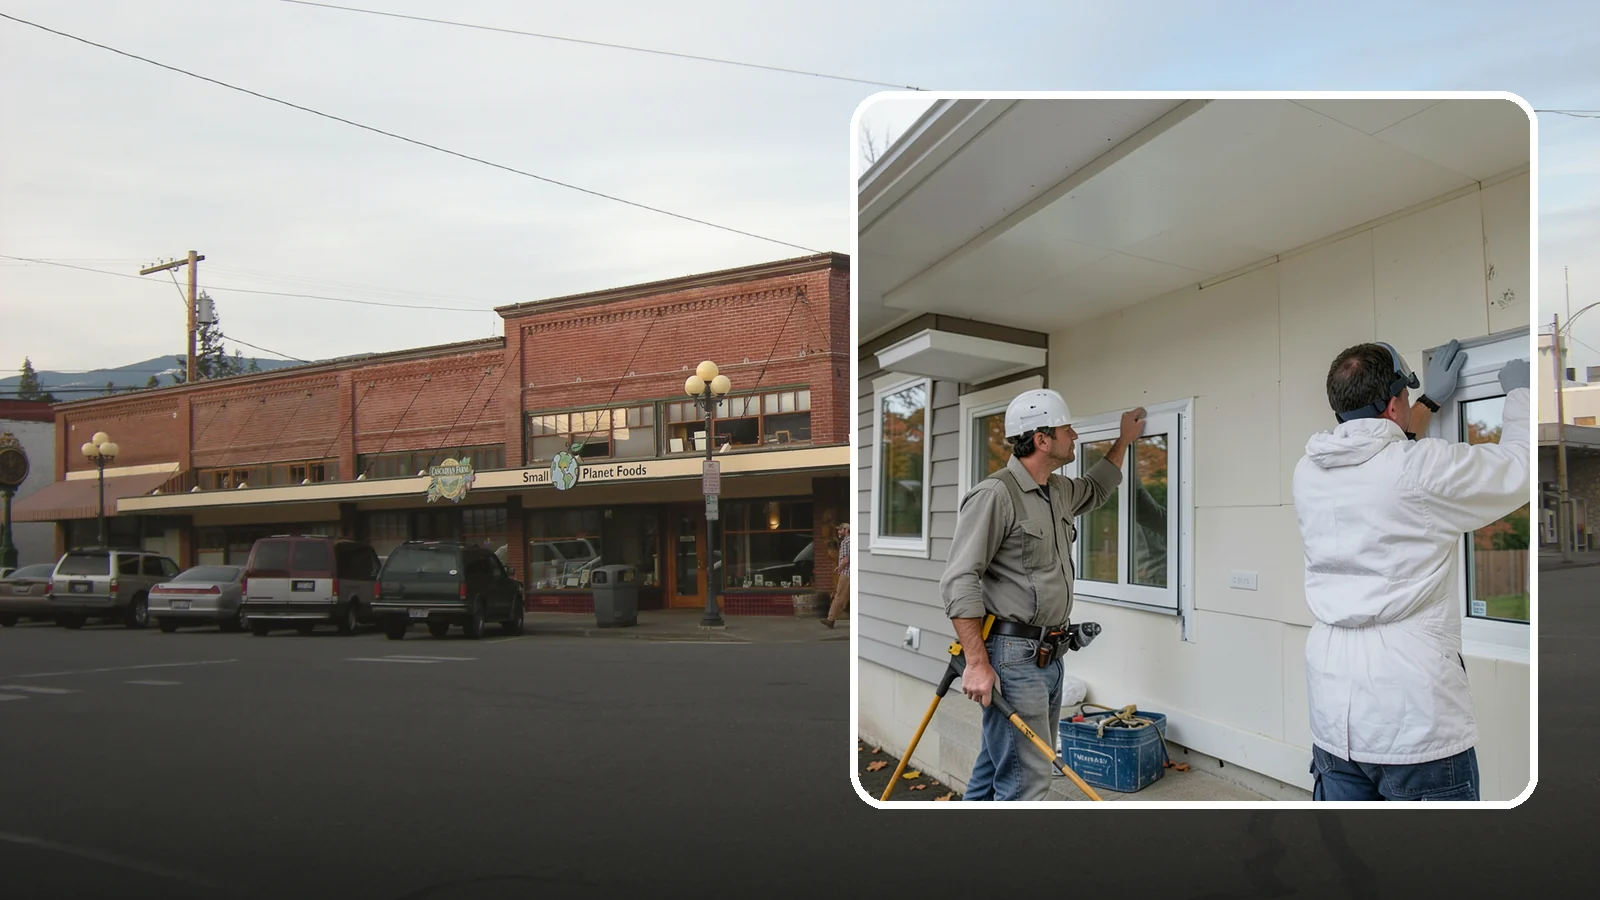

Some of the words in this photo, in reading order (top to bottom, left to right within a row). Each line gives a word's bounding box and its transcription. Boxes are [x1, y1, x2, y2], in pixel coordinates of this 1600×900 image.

[523, 472, 549, 483] Small
[583, 468, 614, 479] Planet
[617, 465, 647, 476] Foods
